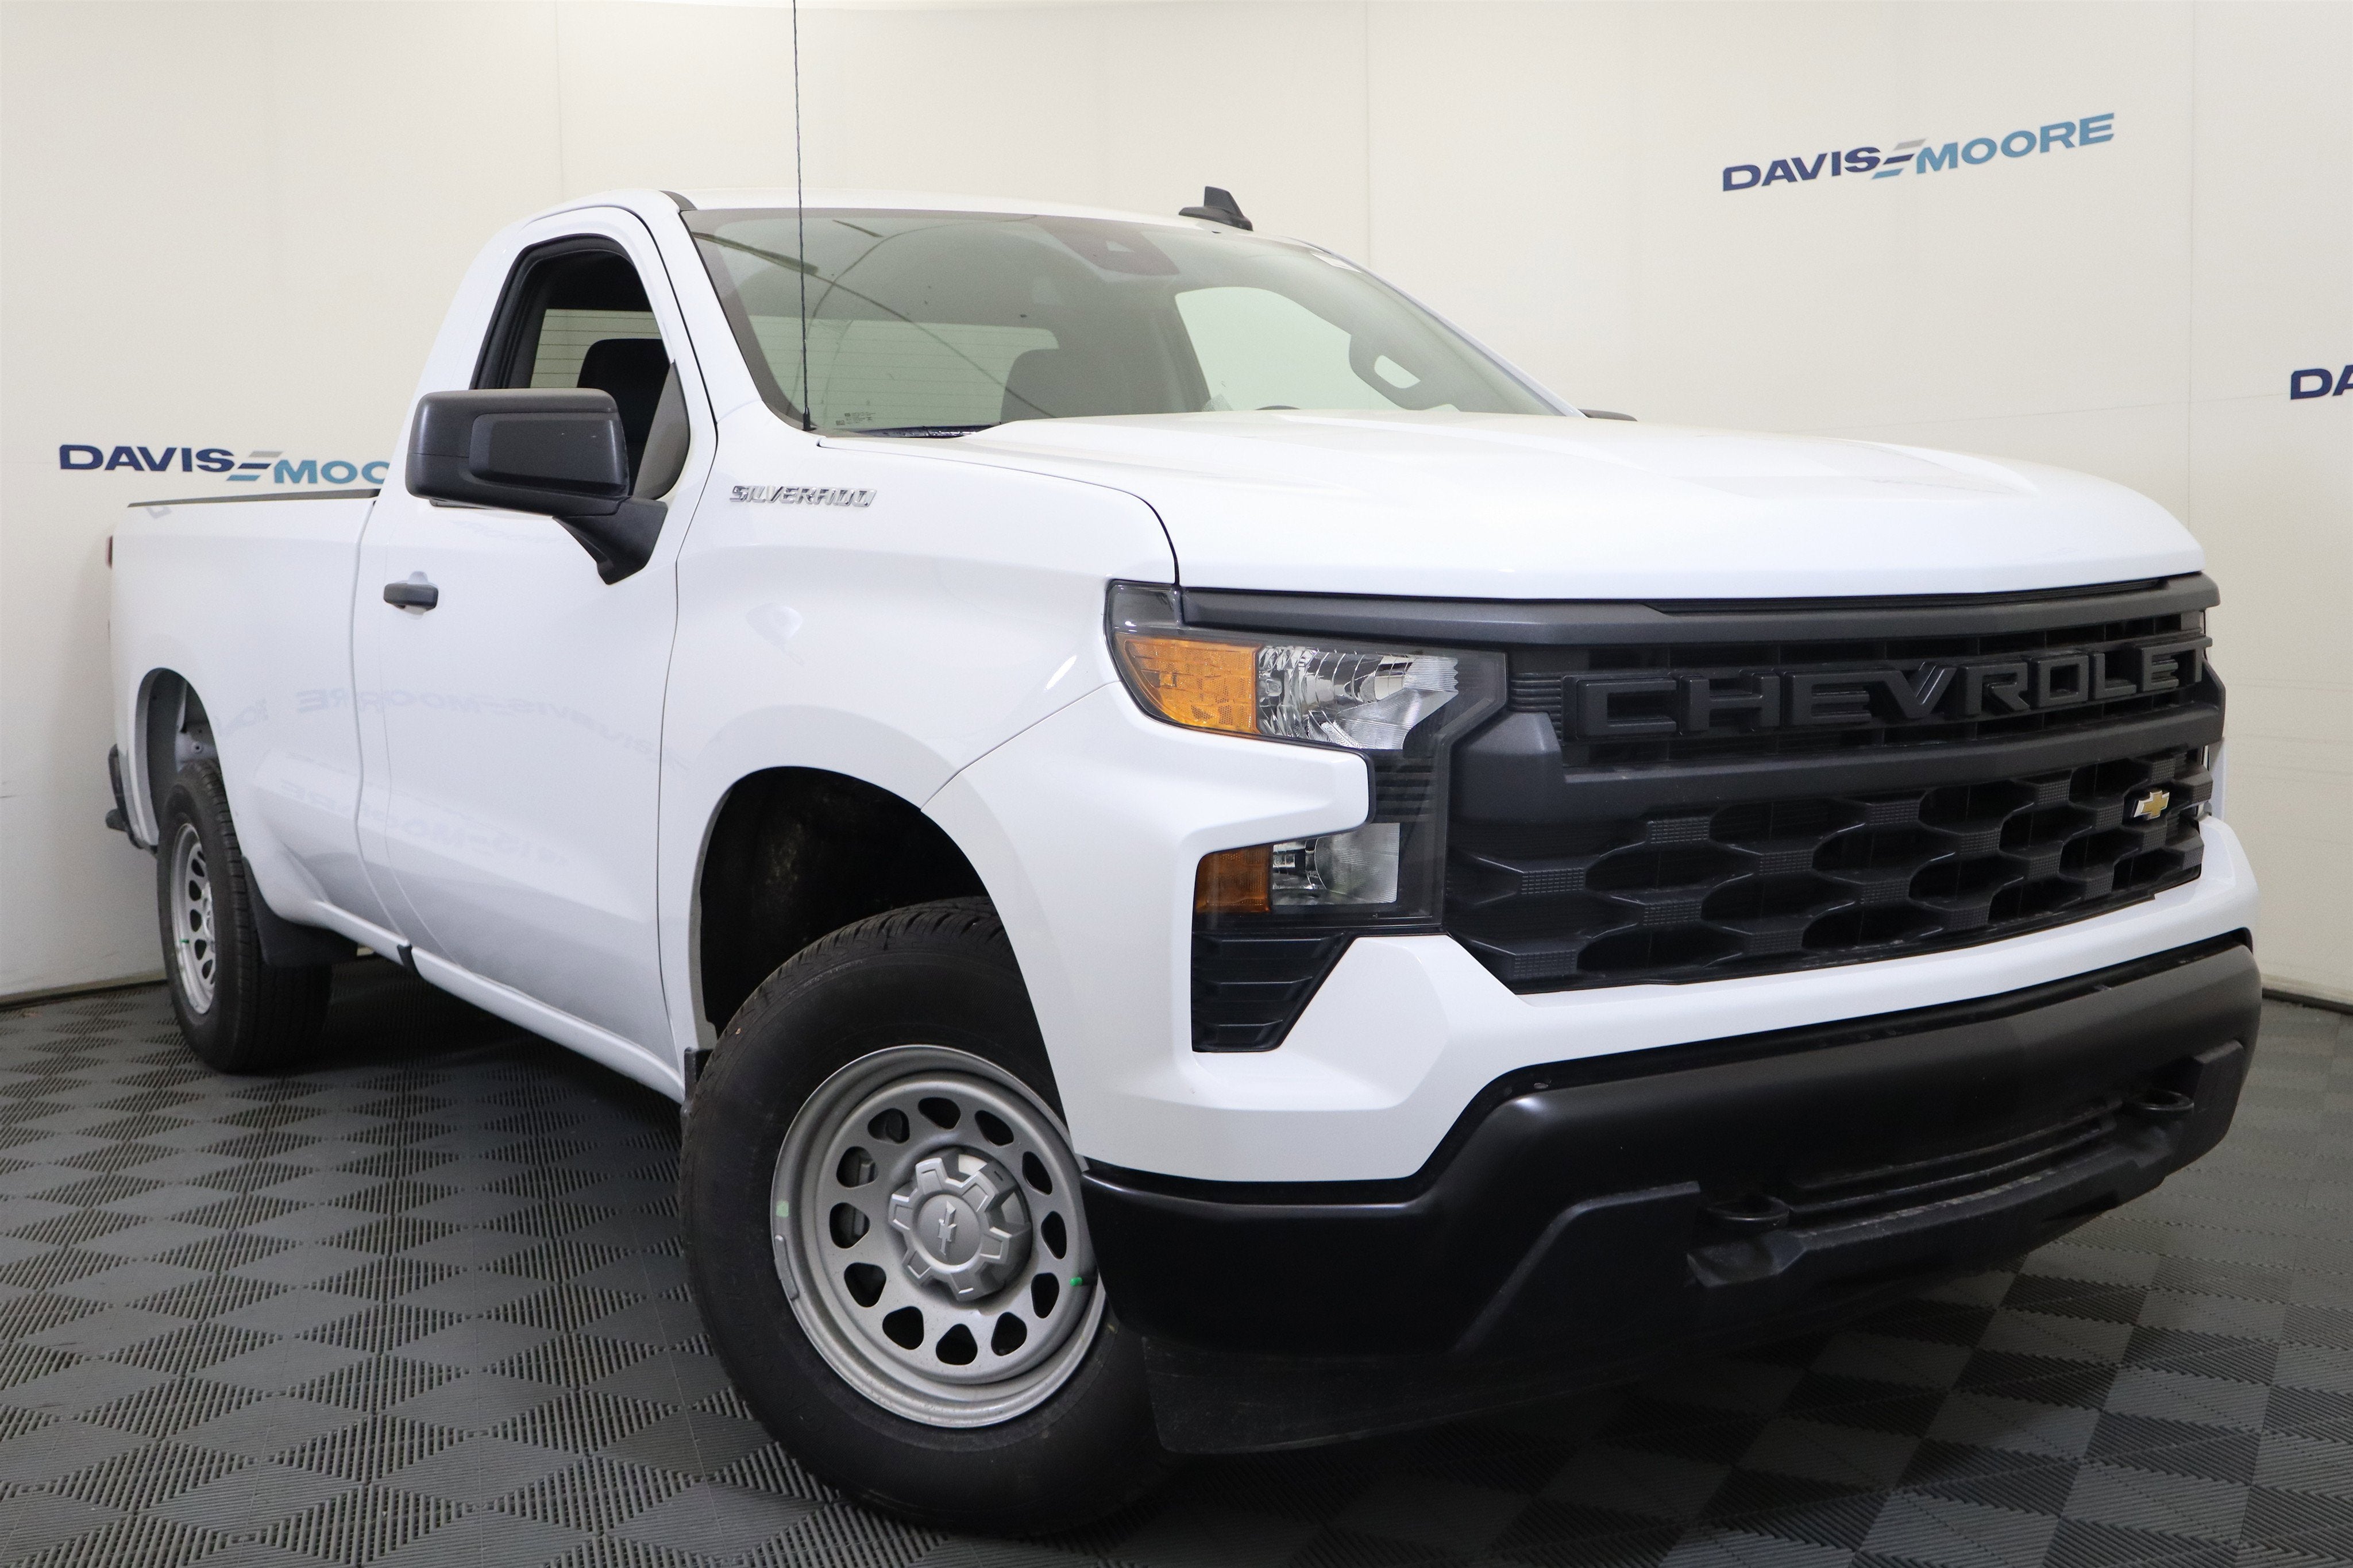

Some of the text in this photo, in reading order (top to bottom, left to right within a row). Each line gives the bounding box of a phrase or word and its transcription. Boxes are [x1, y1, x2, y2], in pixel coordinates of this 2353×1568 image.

[1722, 113, 2115, 191] DAVIS MOORE
[59, 443, 234, 472] DAVIS
[730, 485, 877, 507] SILVERADO
[1564, 636, 2213, 740] CHEVROLET
